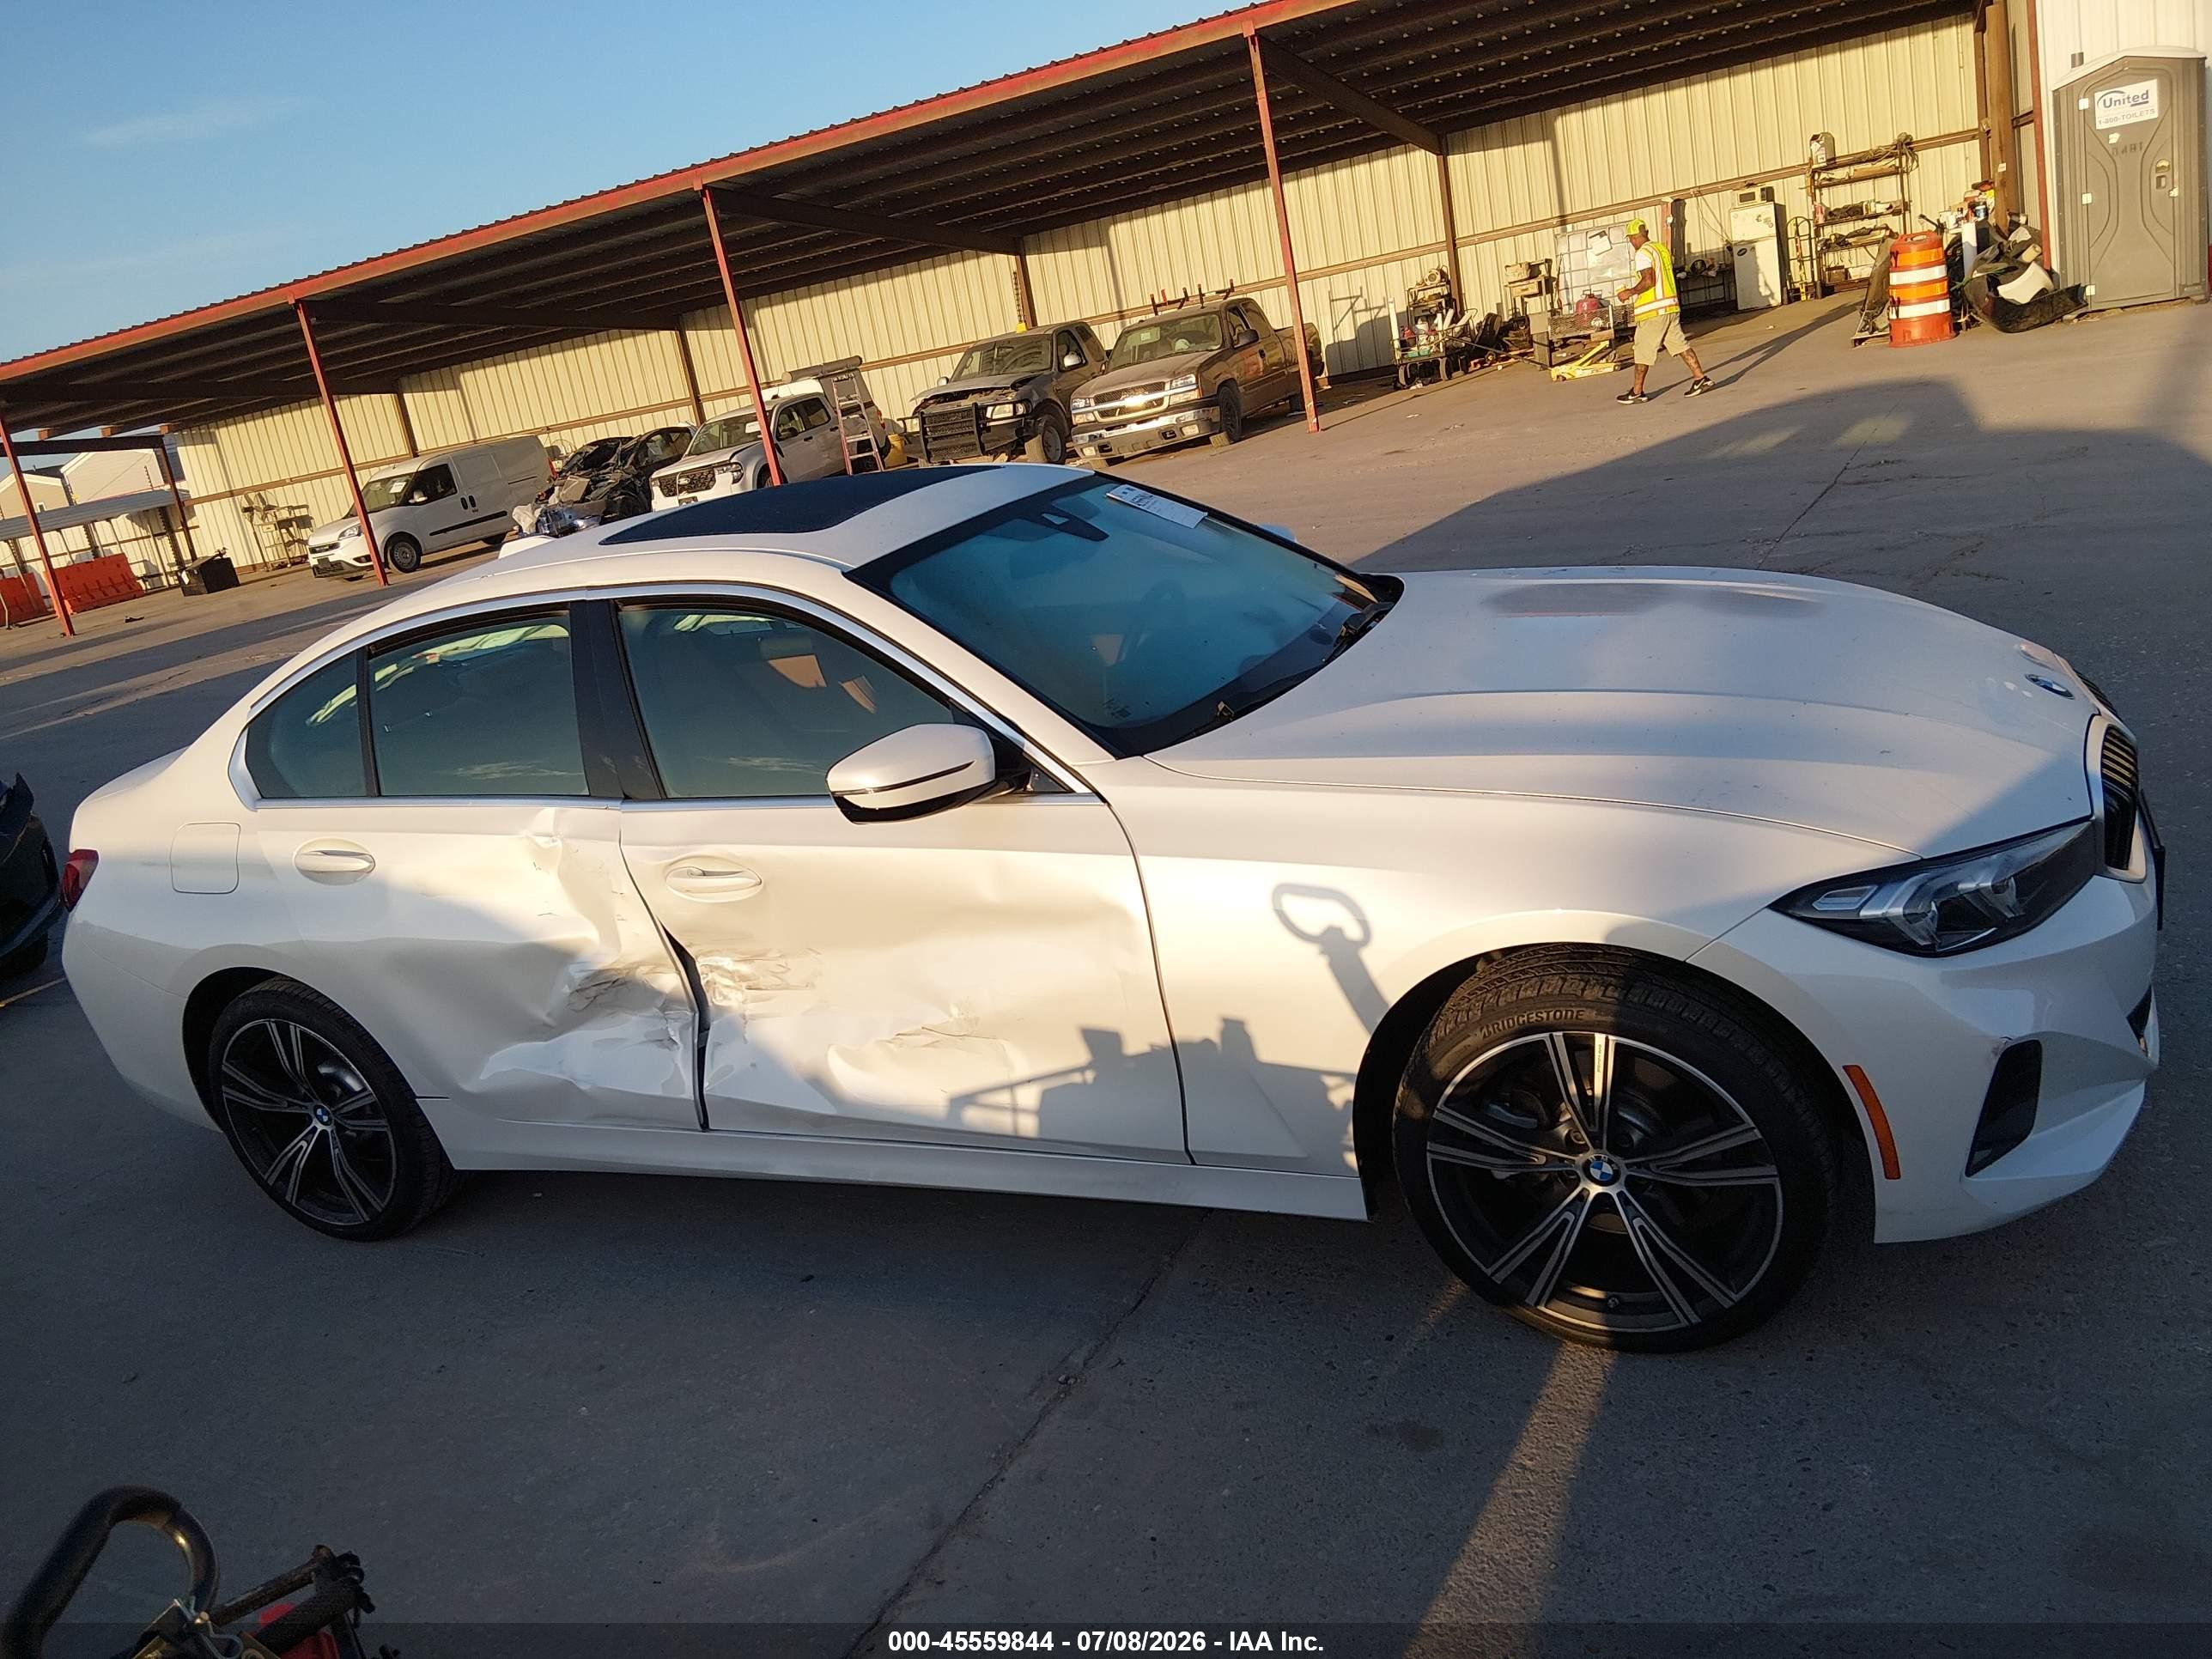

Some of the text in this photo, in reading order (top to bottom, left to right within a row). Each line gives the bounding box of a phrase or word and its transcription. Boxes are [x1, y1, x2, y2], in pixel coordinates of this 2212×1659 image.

[2103, 89, 2149, 108] United
[2098, 108, 2156, 125] 1-800-TOILETS
[1480, 1009, 1586, 1041] BRIDGESTONE
